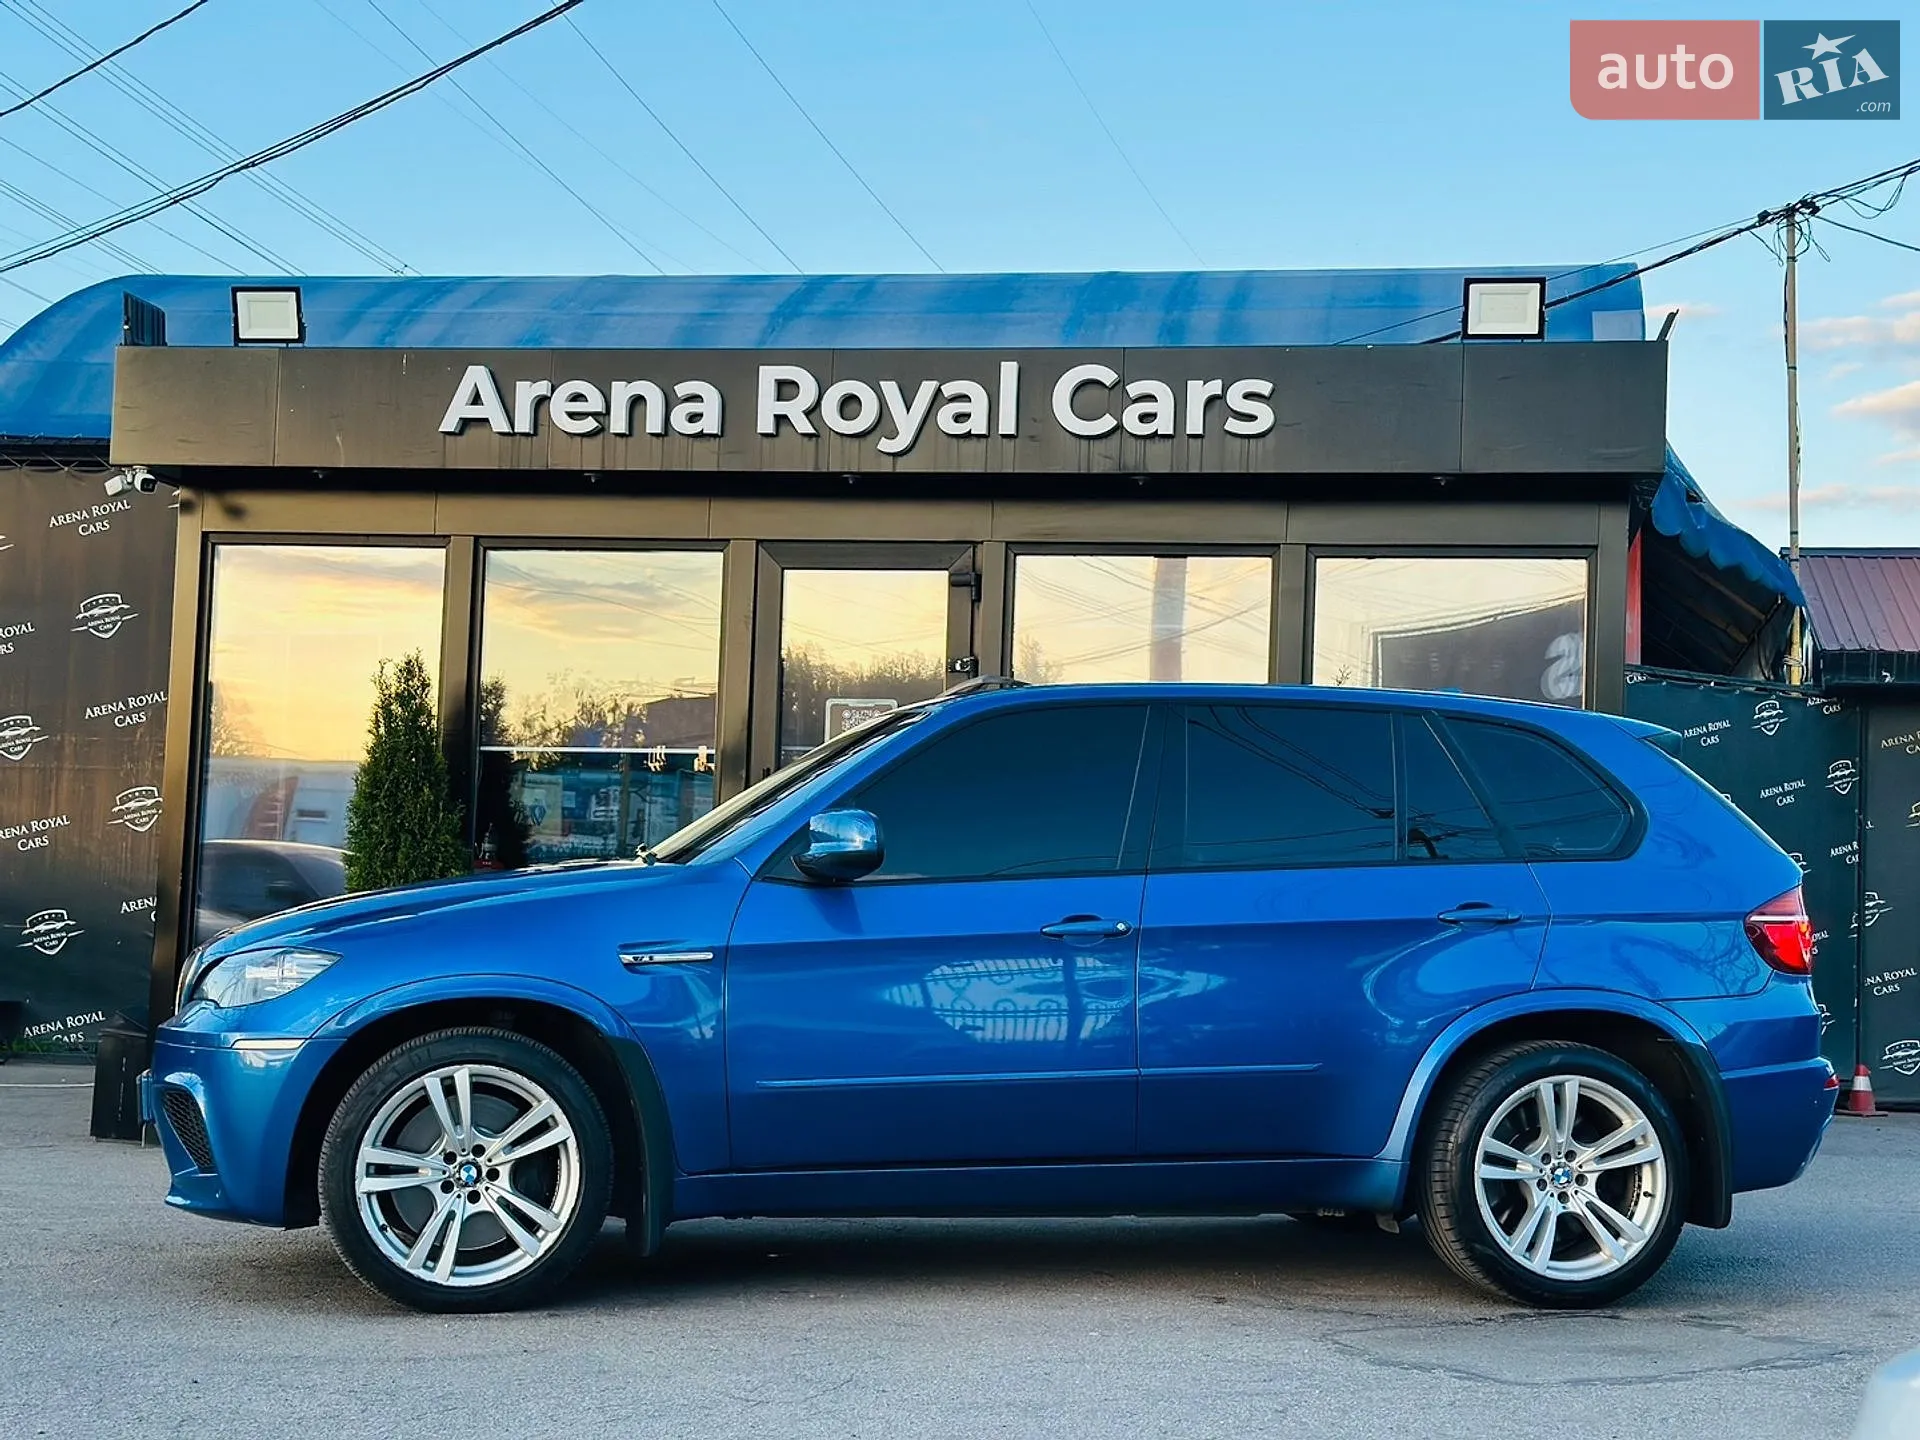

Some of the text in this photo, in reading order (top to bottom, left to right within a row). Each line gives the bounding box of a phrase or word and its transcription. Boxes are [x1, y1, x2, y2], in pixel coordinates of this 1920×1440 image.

[438, 361, 1276, 455] Arena Royal Cars
[49, 499, 131, 528] ARENA ROYAL
[78, 519, 110, 536] CARS
[85, 691, 168, 719] ARENA ROYAL
[114, 711, 147, 728] CARS
[1683, 719, 1731, 739] ARENA ROYAL
[1700, 734, 1720, 747] CARS
[1881, 734, 1915, 749] ARENA
[1759, 779, 1806, 799] ARENA ROYAL
[1776, 794, 1795, 807] CARS
[0, 814, 71, 840] RENA ROYAL
[17, 834, 49, 851] CARS
[1883, 967, 1918, 982] ROYAL
[1873, 982, 1901, 996] CARS
[23, 1010, 106, 1039] ARENA ROYAL
